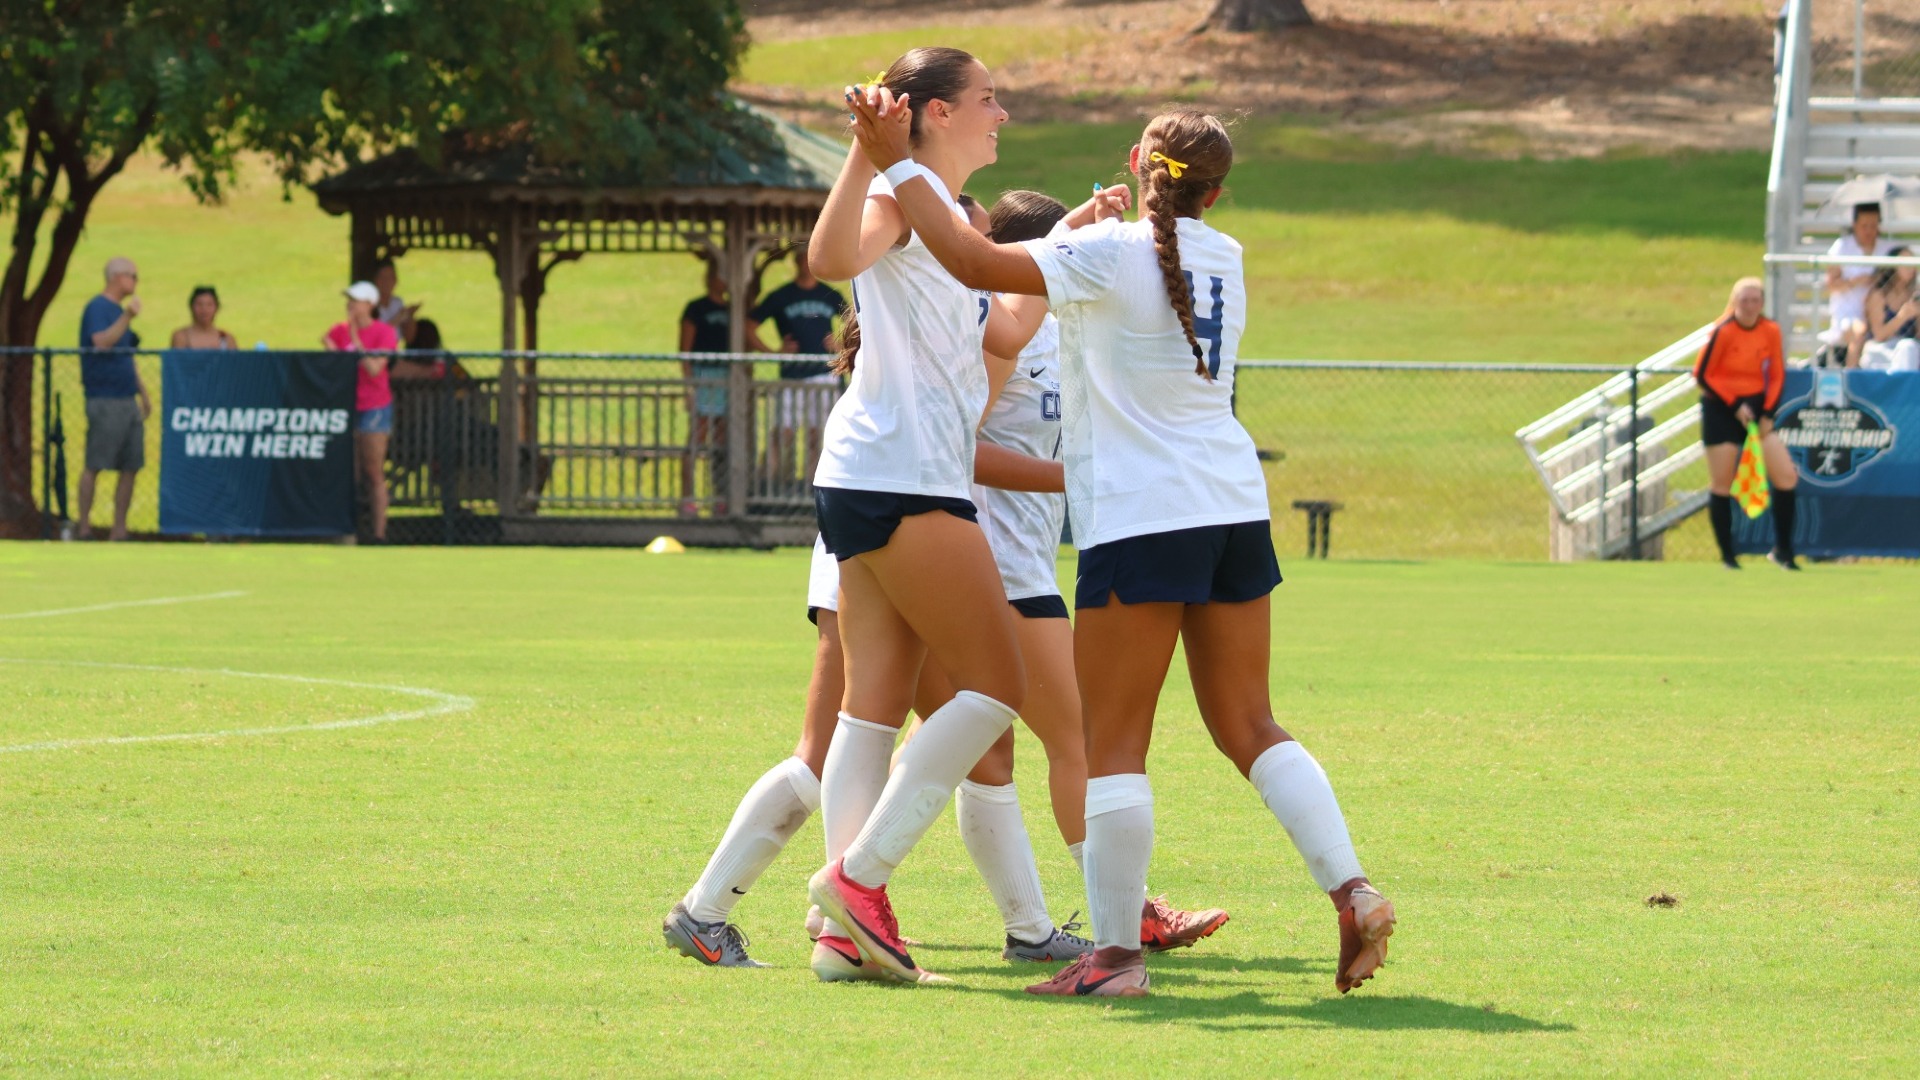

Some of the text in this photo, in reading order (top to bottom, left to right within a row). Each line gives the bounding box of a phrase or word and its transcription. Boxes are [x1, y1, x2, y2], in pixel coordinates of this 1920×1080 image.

[171, 406, 349, 433] CHAMPIONS
[184, 432, 327, 459] WIN HERE
[1778, 428, 1892, 448] HAMPIONSHIP
